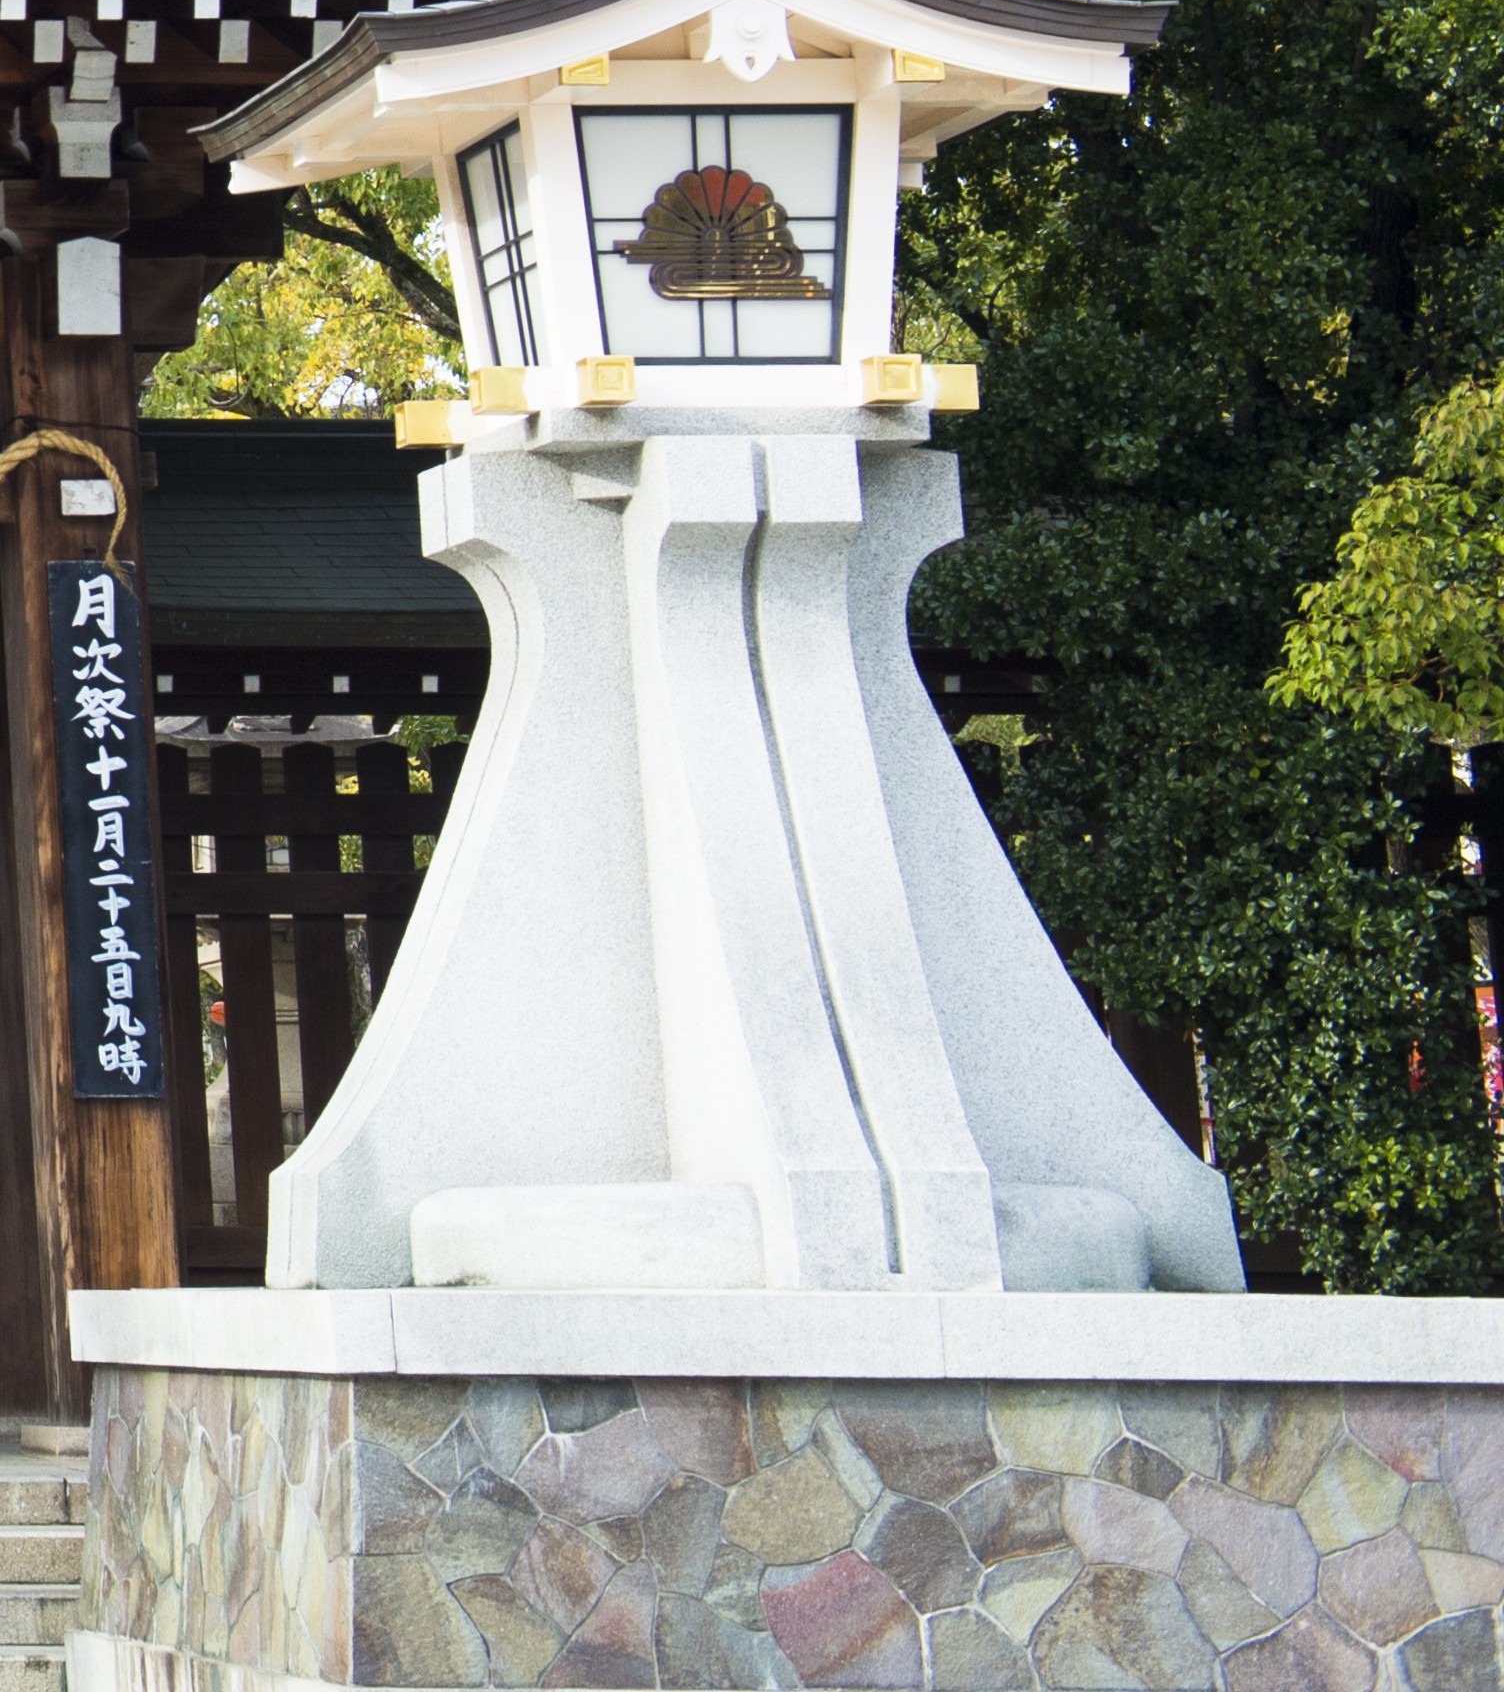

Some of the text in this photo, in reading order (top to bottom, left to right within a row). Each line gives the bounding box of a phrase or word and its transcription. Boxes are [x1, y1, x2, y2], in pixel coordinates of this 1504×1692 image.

[70, 573, 148, 1085] 月次祭十一月二十五日九時
